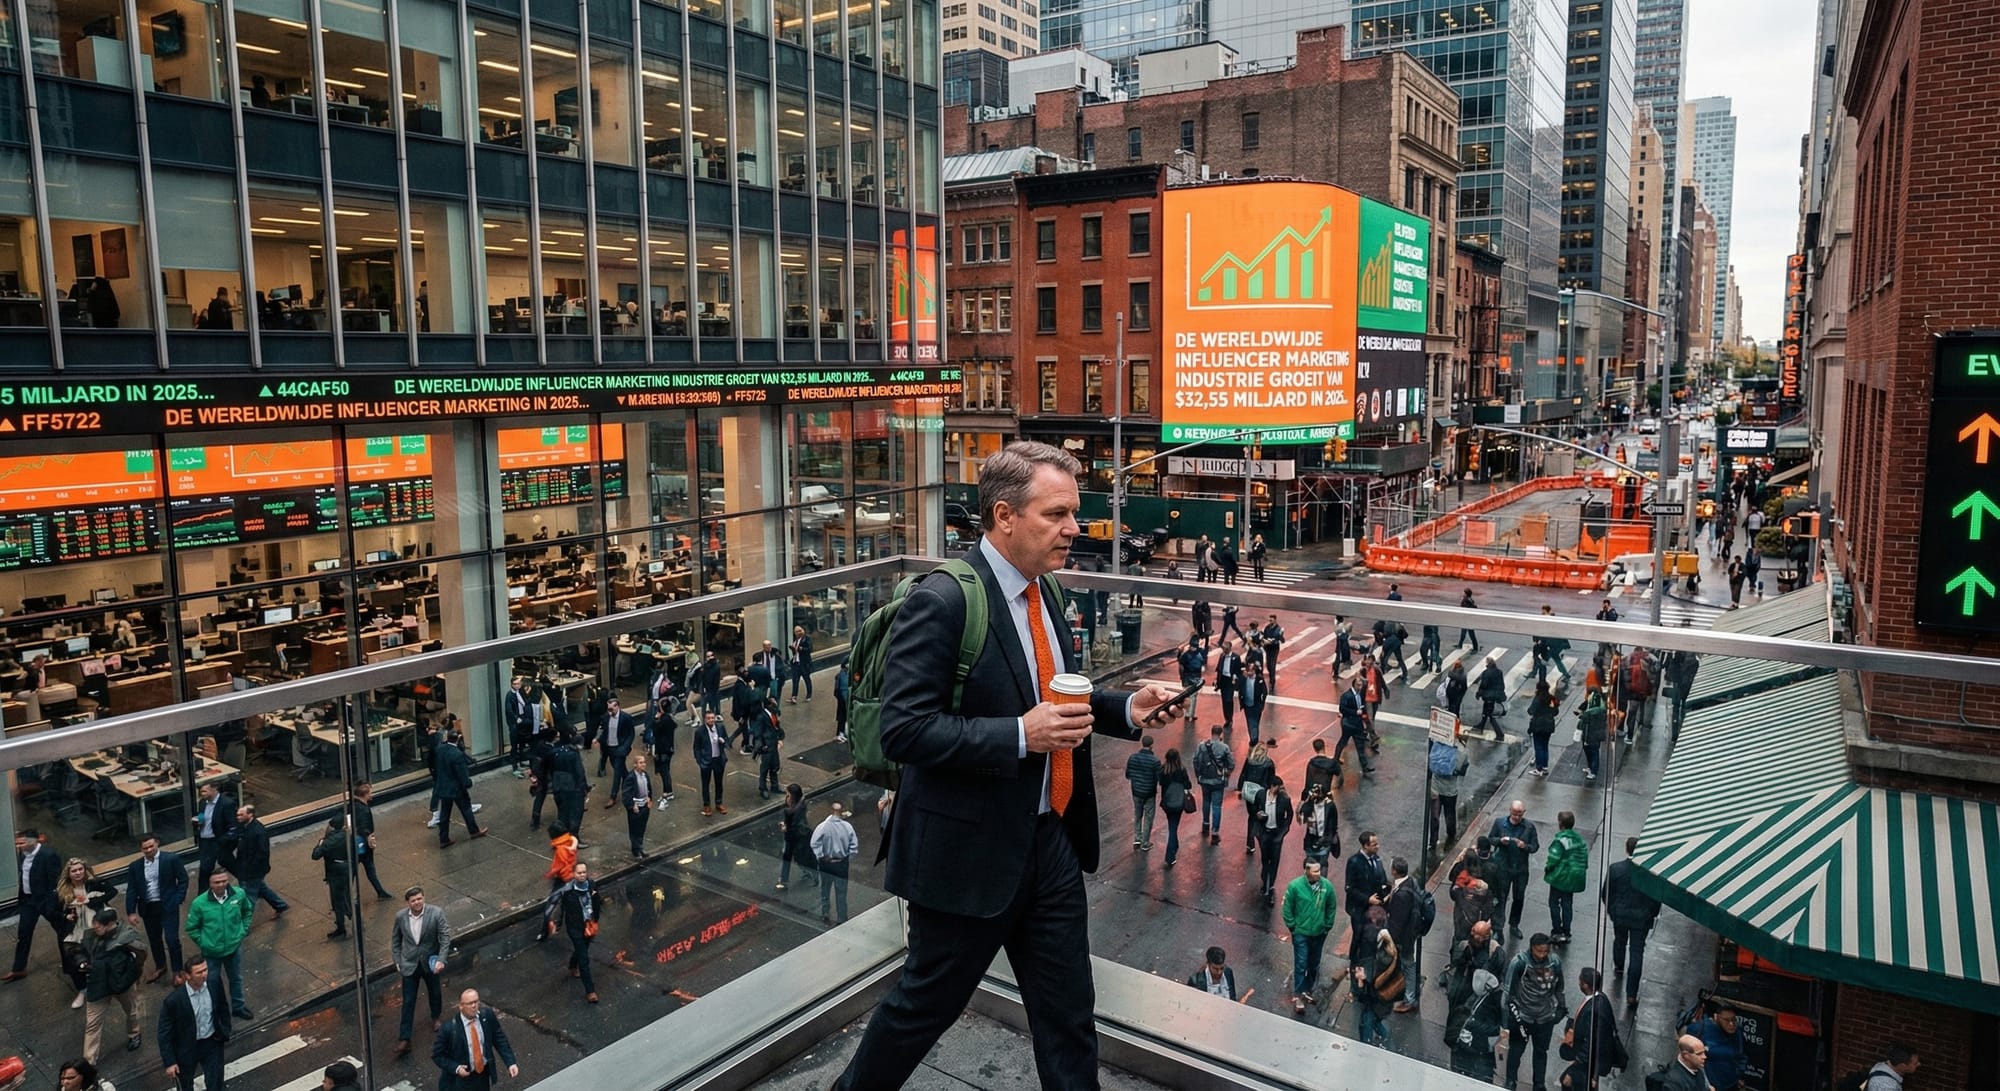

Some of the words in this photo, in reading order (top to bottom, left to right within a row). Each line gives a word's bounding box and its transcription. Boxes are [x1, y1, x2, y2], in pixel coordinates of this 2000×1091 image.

[1175, 332, 1196, 348] DE
[1201, 331, 1323, 348] WERELDWIJDE
[1175, 352, 1280, 368] INFLUENCER
[1286, 351, 1350, 367] MARKETING
[394, 379, 416, 395] DE
[419, 377, 523, 394] WERELDWIJDE
[526, 375, 603, 391] INFLUENCER
[605, 375, 670, 389] MARKETING
[672, 374, 724, 387] INDUSTRIE
[725, 373, 760, 386] GROEIT
[761, 372, 780, 385] VAN
[1175, 371, 1264, 388] INDUSTRIE
[1269, 371, 1325, 387] GROEIT
[1326, 371, 1343, 386] VAN
[21, 385, 121, 404] MILJARD
[126, 384, 147, 402] IN
[153, 384, 215, 401] 2025...
[277, 381, 350, 397] 44CAF50
[788, 388, 800, 400] DE
[1175, 390, 1228, 409] $32,55
[1233, 391, 1307, 408] MILJARD
[1311, 391, 1323, 406] IN
[165, 408, 194, 426] DE
[198, 403, 334, 425] WERELDWIJDE
[338, 400, 441, 418] INFLUENCER
[444, 396, 531, 414] MARKETING
[534, 396, 547, 411] IN
[550, 395, 590, 410] 2025...
[22, 411, 101, 432] FF5722
